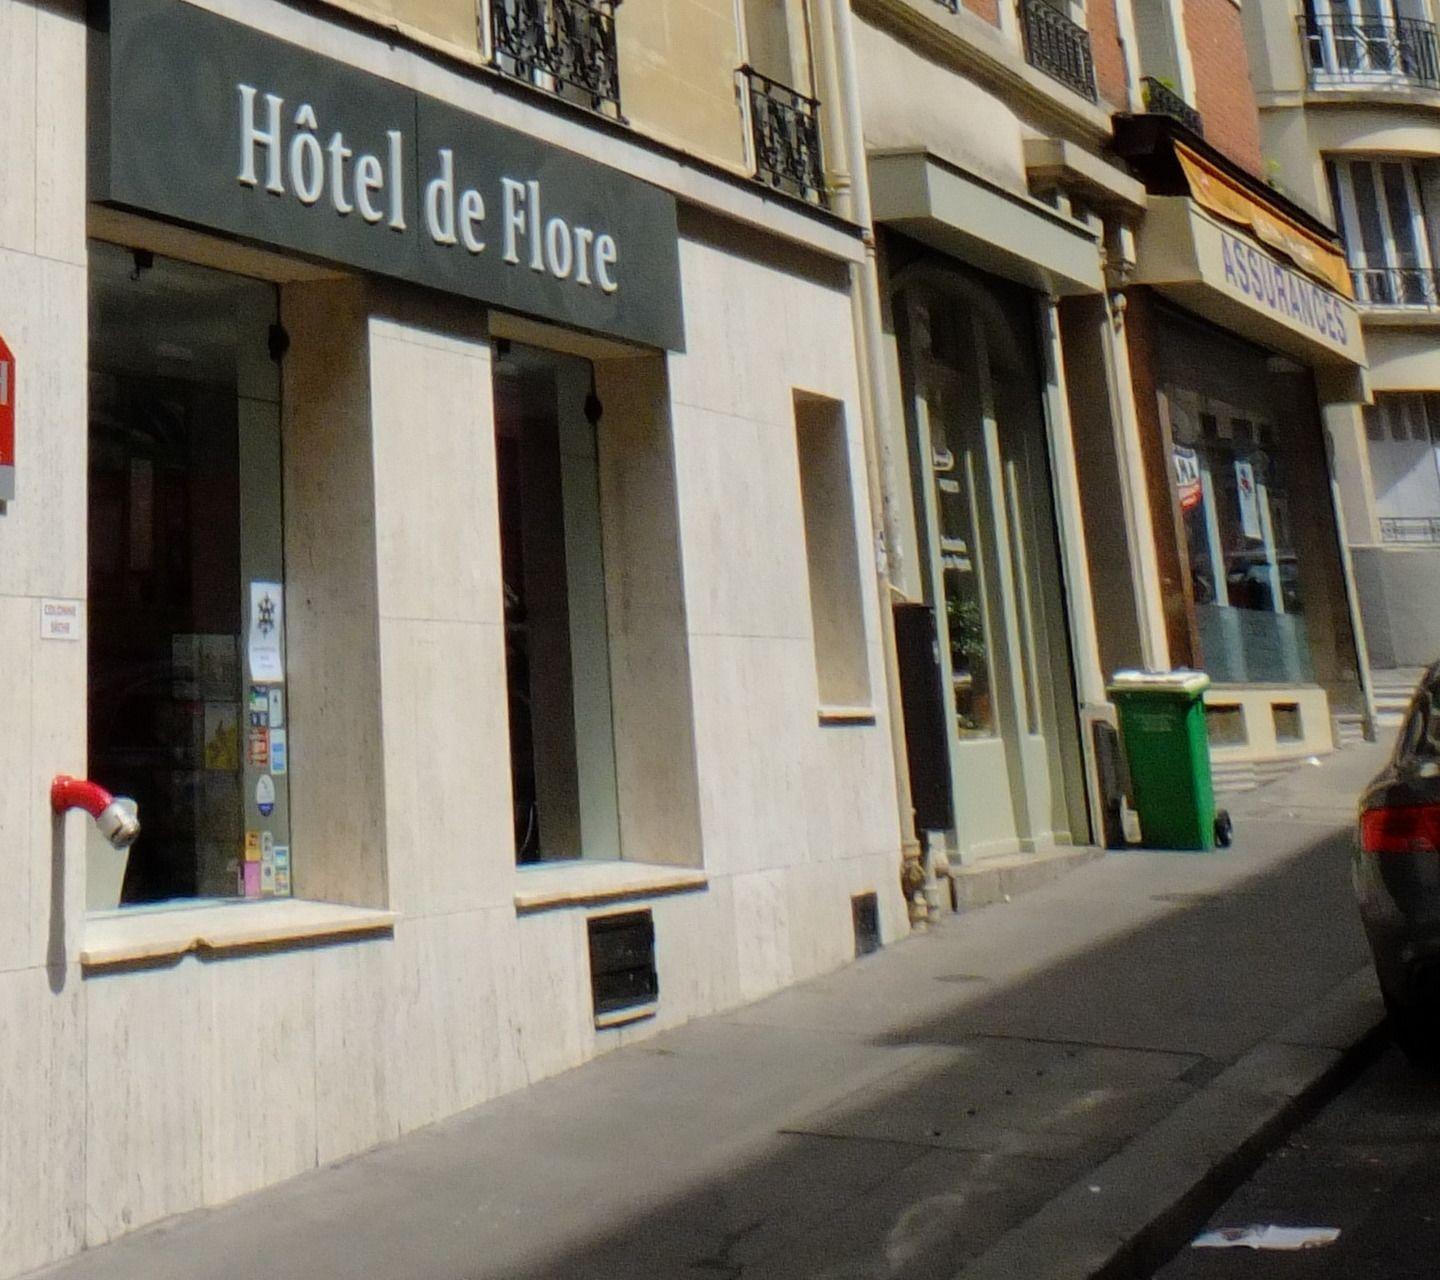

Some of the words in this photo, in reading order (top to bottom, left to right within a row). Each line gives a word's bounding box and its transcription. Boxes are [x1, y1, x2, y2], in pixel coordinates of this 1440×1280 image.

[237, 83, 407, 232] Hôtel
[425, 148, 486, 254] de
[501, 176, 619, 295] Flore
[1221, 233, 1348, 346] ASSURANCES
